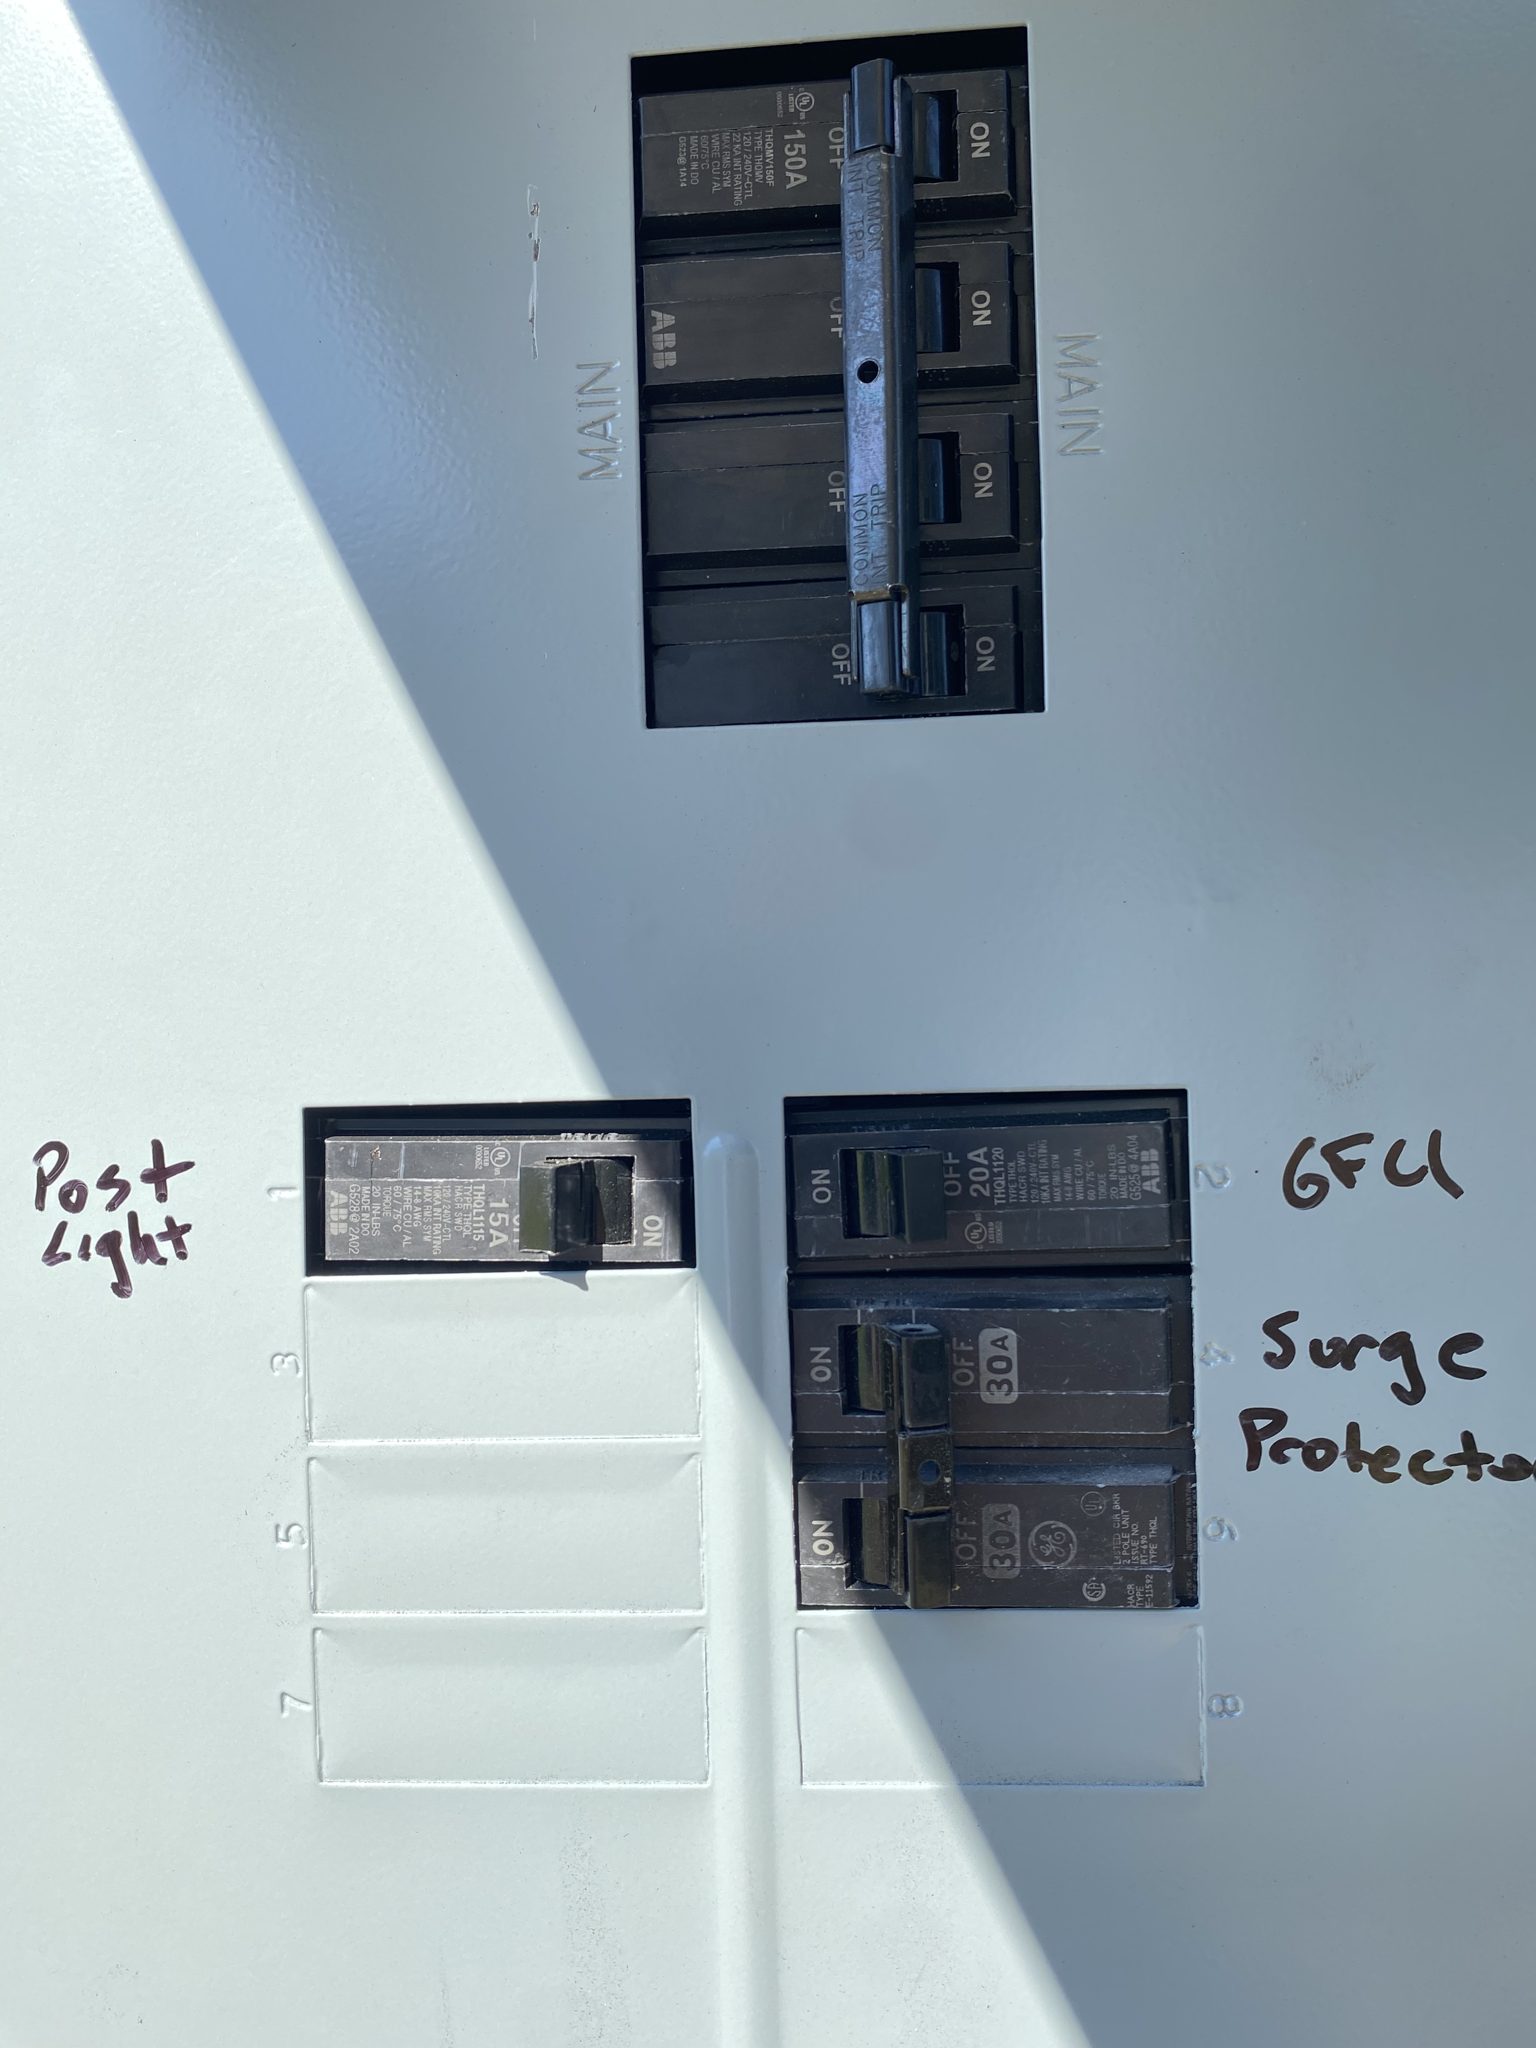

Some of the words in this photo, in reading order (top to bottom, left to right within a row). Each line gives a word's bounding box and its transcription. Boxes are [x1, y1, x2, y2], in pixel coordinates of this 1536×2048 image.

[690, 136, 698, 159] MADE
[711, 134, 719, 157] WIRE
[722, 132, 730, 149] MAX
[733, 132, 741, 142] 22
[743, 131, 751, 146] 120
[754, 131, 762, 151] TYPE
[970, 122, 990, 159] ON
[733, 144, 741, 156] KA
[765, 129, 774, 187] THQMV150F
[783, 130, 807, 189] 150A
[690, 162, 698, 170] IN
[691, 173, 698, 184] DO
[712, 161, 720, 174] CU
[712, 182, 721, 194] AL
[734, 174, 742, 206] RATING
[849, 215, 865, 261] TRIP
[972, 290, 992, 326] ON
[651, 310, 676, 369] ABB
[1055, 334, 1103, 456] MAIN
[576, 362, 622, 480] MAIN
[828, 471, 845, 512] OFF
[973, 462, 993, 498] ON
[871, 484, 887, 530] TRIP
[852, 493, 868, 585] COMMON
[832, 643, 851, 685] OFF
[976, 636, 996, 672] ON
[1038, 1140, 1048, 1169] RATING
[1073, 1147, 1081, 1156] AL
[1127, 1135, 1139, 1160] 4A04
[942, 1152, 961, 1196] OFF
[966, 1146, 990, 1197] 20A
[1017, 1151, 1026, 1173] SWD
[1074, 1161, 1083, 1176] CU
[1140, 1148, 1161, 1194] ABB
[33, 1139, 195, 1214] Post
[811, 1169, 831, 1204] ON
[992, 1147, 1006, 1205] THQL1120
[1039, 1171, 1048, 1183] INT
[1119, 1176, 1128, 1198] MADE
[1194, 1161, 1231, 1189] 2
[266, 1186, 298, 1201] 1
[362, 1187, 370, 1212] MADE
[372, 1186, 380, 1197] 20
[394, 1186, 401, 1197] 60
[433, 1185, 441, 1206] 10KA
[443, 1185, 451, 1198] 120
[464, 1185, 472, 1210] TYPE
[1009, 1182, 1017, 1202] TYPE
[1018, 1176, 1027, 1201] HACR
[1053, 1186, 1062, 1201] MAX
[1075, 1178, 1084, 1200] WIRE
[1087, 1190, 1095, 1200] 60
[1110, 1187, 1118, 1200] 20
[330, 1191, 348, 1235] ABB
[383, 1187, 391, 1217] TORQUE
[433, 1208, 441, 1221] INT
[473, 1184, 485, 1241] THQL1115
[362, 1213, 370, 1221] IN
[372, 1203, 380, 1236] IN-LBS
[403, 1214, 411, 1229] CU
[413, 1206, 421, 1227] AWG
[454, 1212, 462, 1231] SWD
[463, 1212, 471, 1238] THQL
[489, 1198, 508, 1248] 15A
[349, 1227, 359, 1254] 2A02
[362, 1223, 370, 1236] DO
[403, 1235, 411, 1247] AL
[423, 1225, 431, 1242] SYM
[433, 1224, 441, 1254] RATING
[643, 1215, 664, 1246] ON
[42, 1211, 192, 1298] Light
[270, 1352, 303, 1378] 3
[810, 1347, 832, 1382] ON
[952, 1337, 974, 1386] OFF
[987, 1335, 1013, 1396] 30A
[1262, 1310, 1488, 1406] Surge
[1238, 1408, 1536, 1486] Protecto
[1113, 1492, 1121, 1509] BKR
[1121, 1509, 1129, 1529] UNIT
[1149, 1516, 1158, 1537] THQL
[1203, 1516, 1238, 1542] 6
[275, 1523, 308, 1549] 5
[811, 1520, 834, 1556] ON
[955, 1511, 977, 1561] OFF
[989, 1510, 1017, 1571] 30A
[1113, 1533, 1121, 1564] LISTED
[1122, 1533, 1130, 1556] POLE
[1131, 1539, 1139, 1564] ISSUE
[1140, 1535, 1148, 1564] RT-690
[1149, 1543, 1157, 1564] TYPE
[1127, 1584, 1136, 1606] HACR
[1136, 1586, 1145, 1606] TYPE
[280, 1691, 313, 1719] 7
[1207, 1694, 1244, 1718] 8
